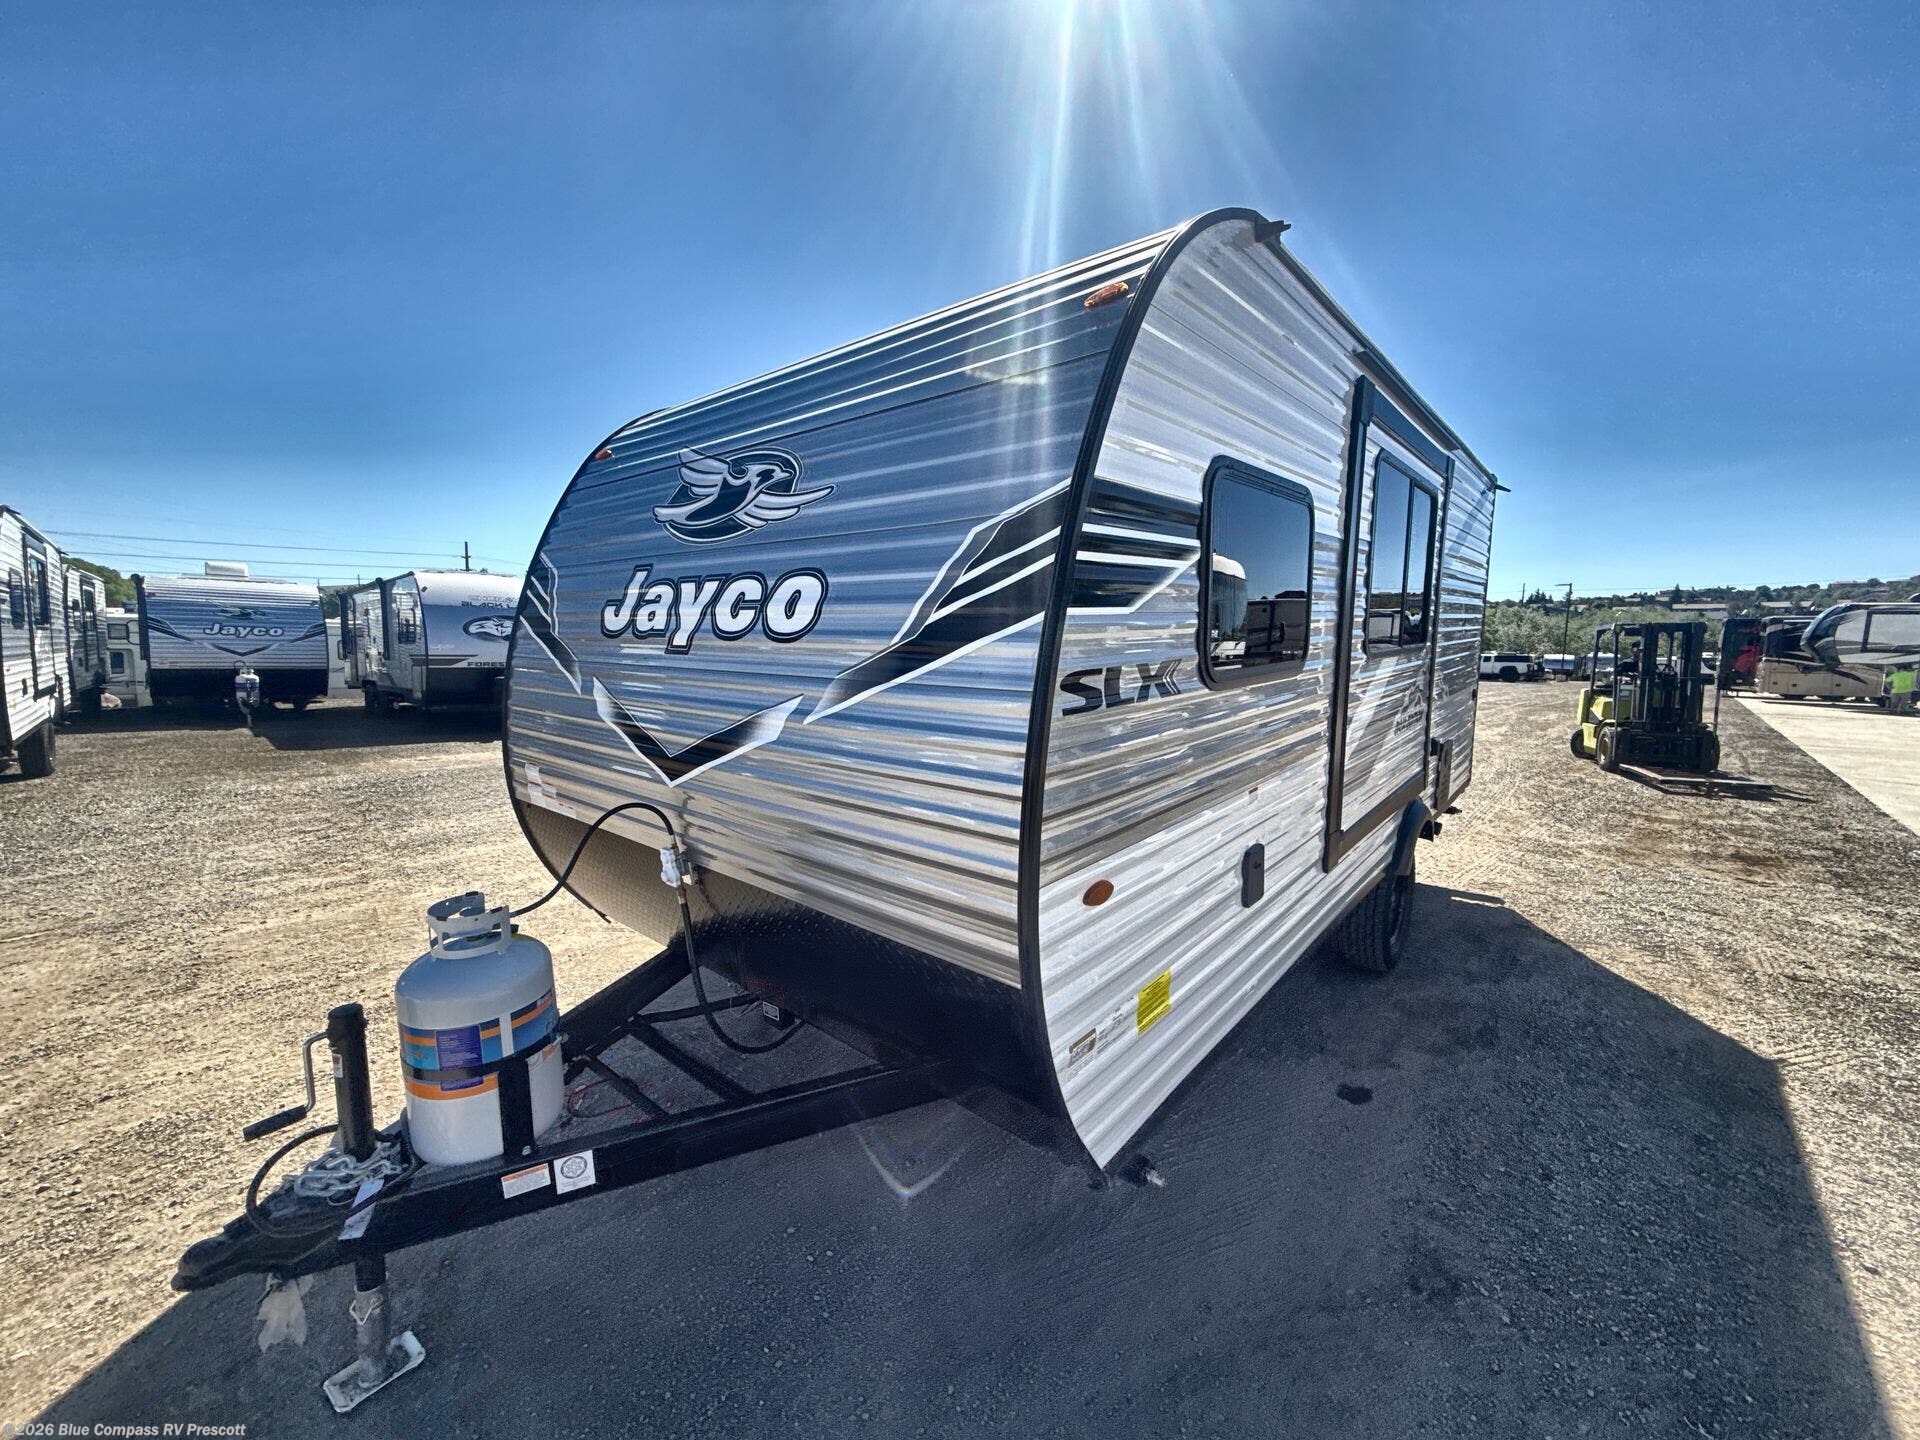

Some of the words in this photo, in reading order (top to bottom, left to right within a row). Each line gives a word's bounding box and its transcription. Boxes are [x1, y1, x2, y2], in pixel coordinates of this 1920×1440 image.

[203, 622, 285, 638] Jayco
[601, 563, 829, 655] Jayco
[1060, 658, 1182, 716] SLX
